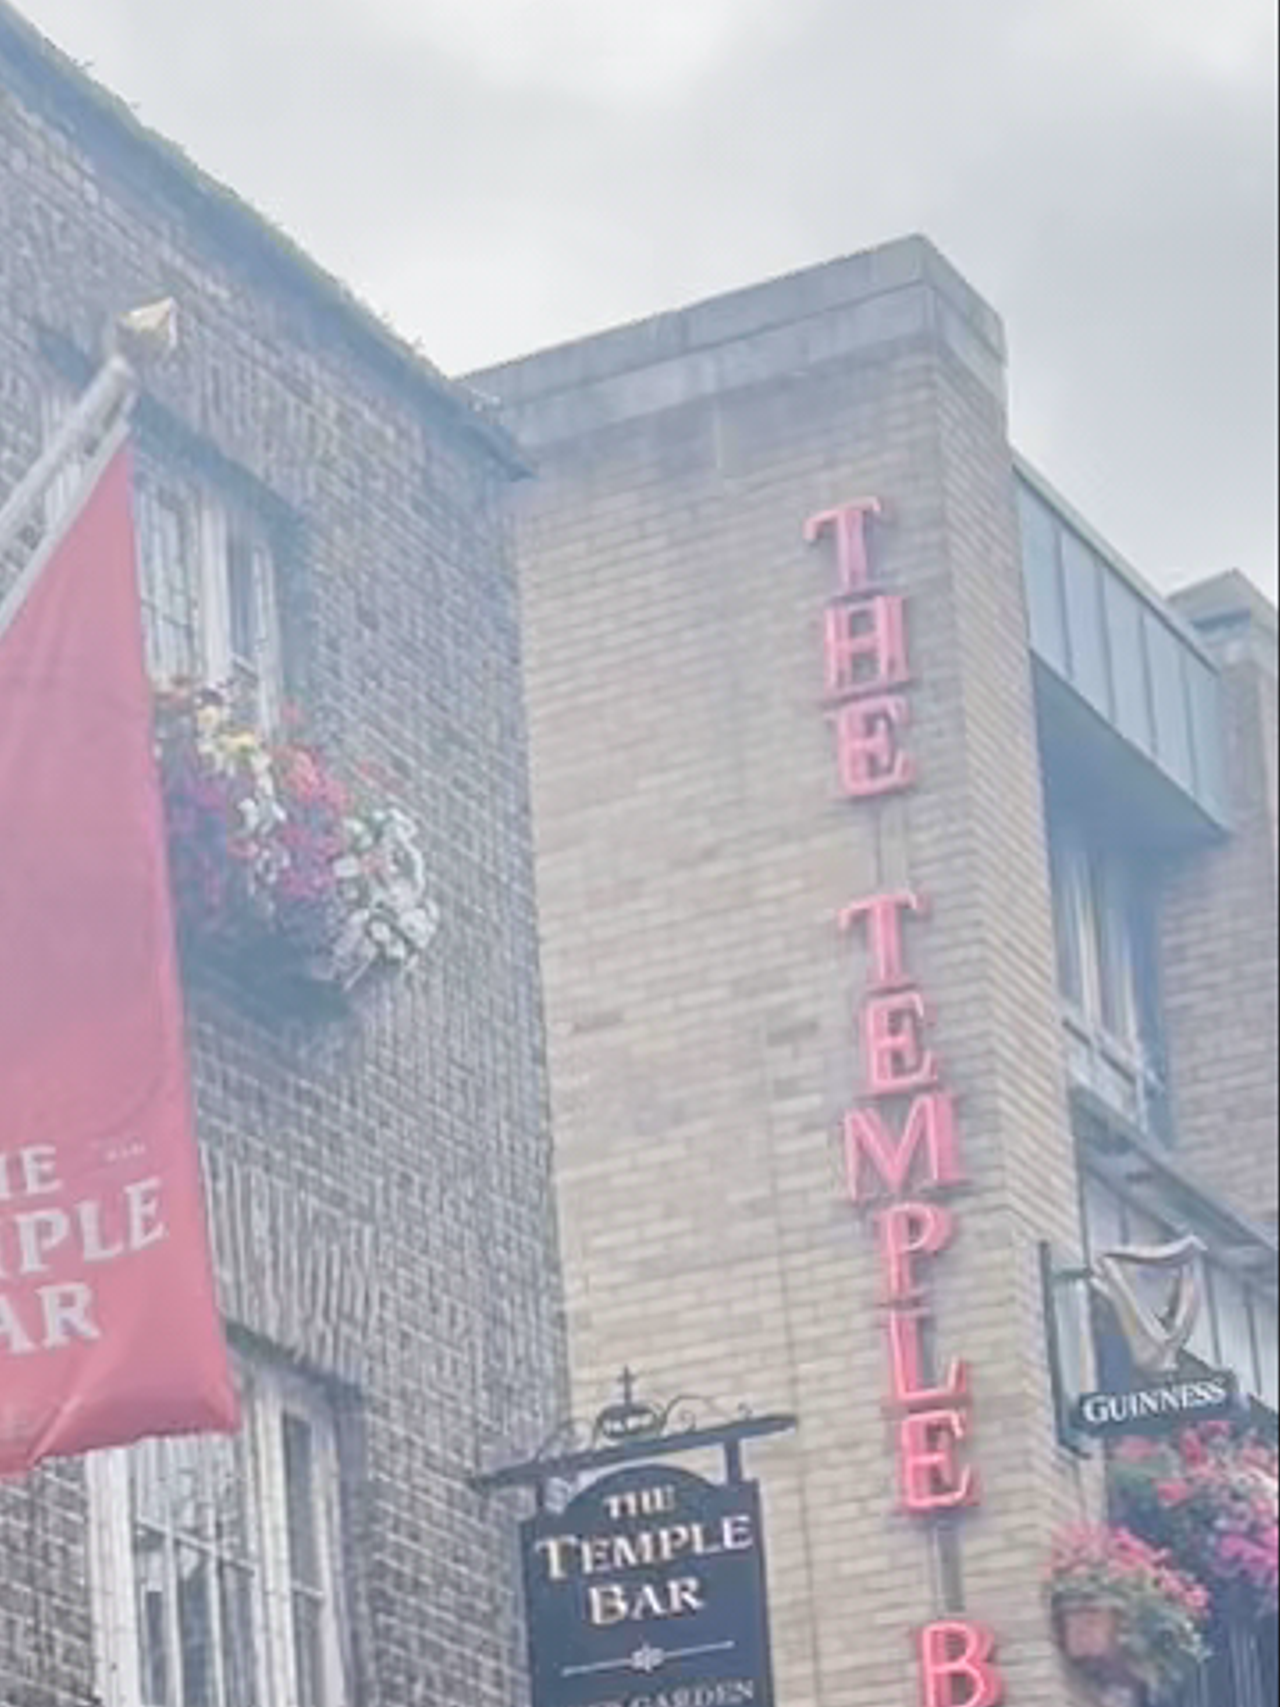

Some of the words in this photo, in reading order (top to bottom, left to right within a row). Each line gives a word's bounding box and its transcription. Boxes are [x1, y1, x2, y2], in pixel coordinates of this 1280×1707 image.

[803, 496, 912, 800] THE
[838, 892, 981, 1514] TEMPLE
[1082, 1376, 1226, 1423] GUINNESS
[604, 1486, 676, 1519] THE
[535, 1515, 754, 1580] TEMPLE
[589, 1576, 705, 1627] BAR
